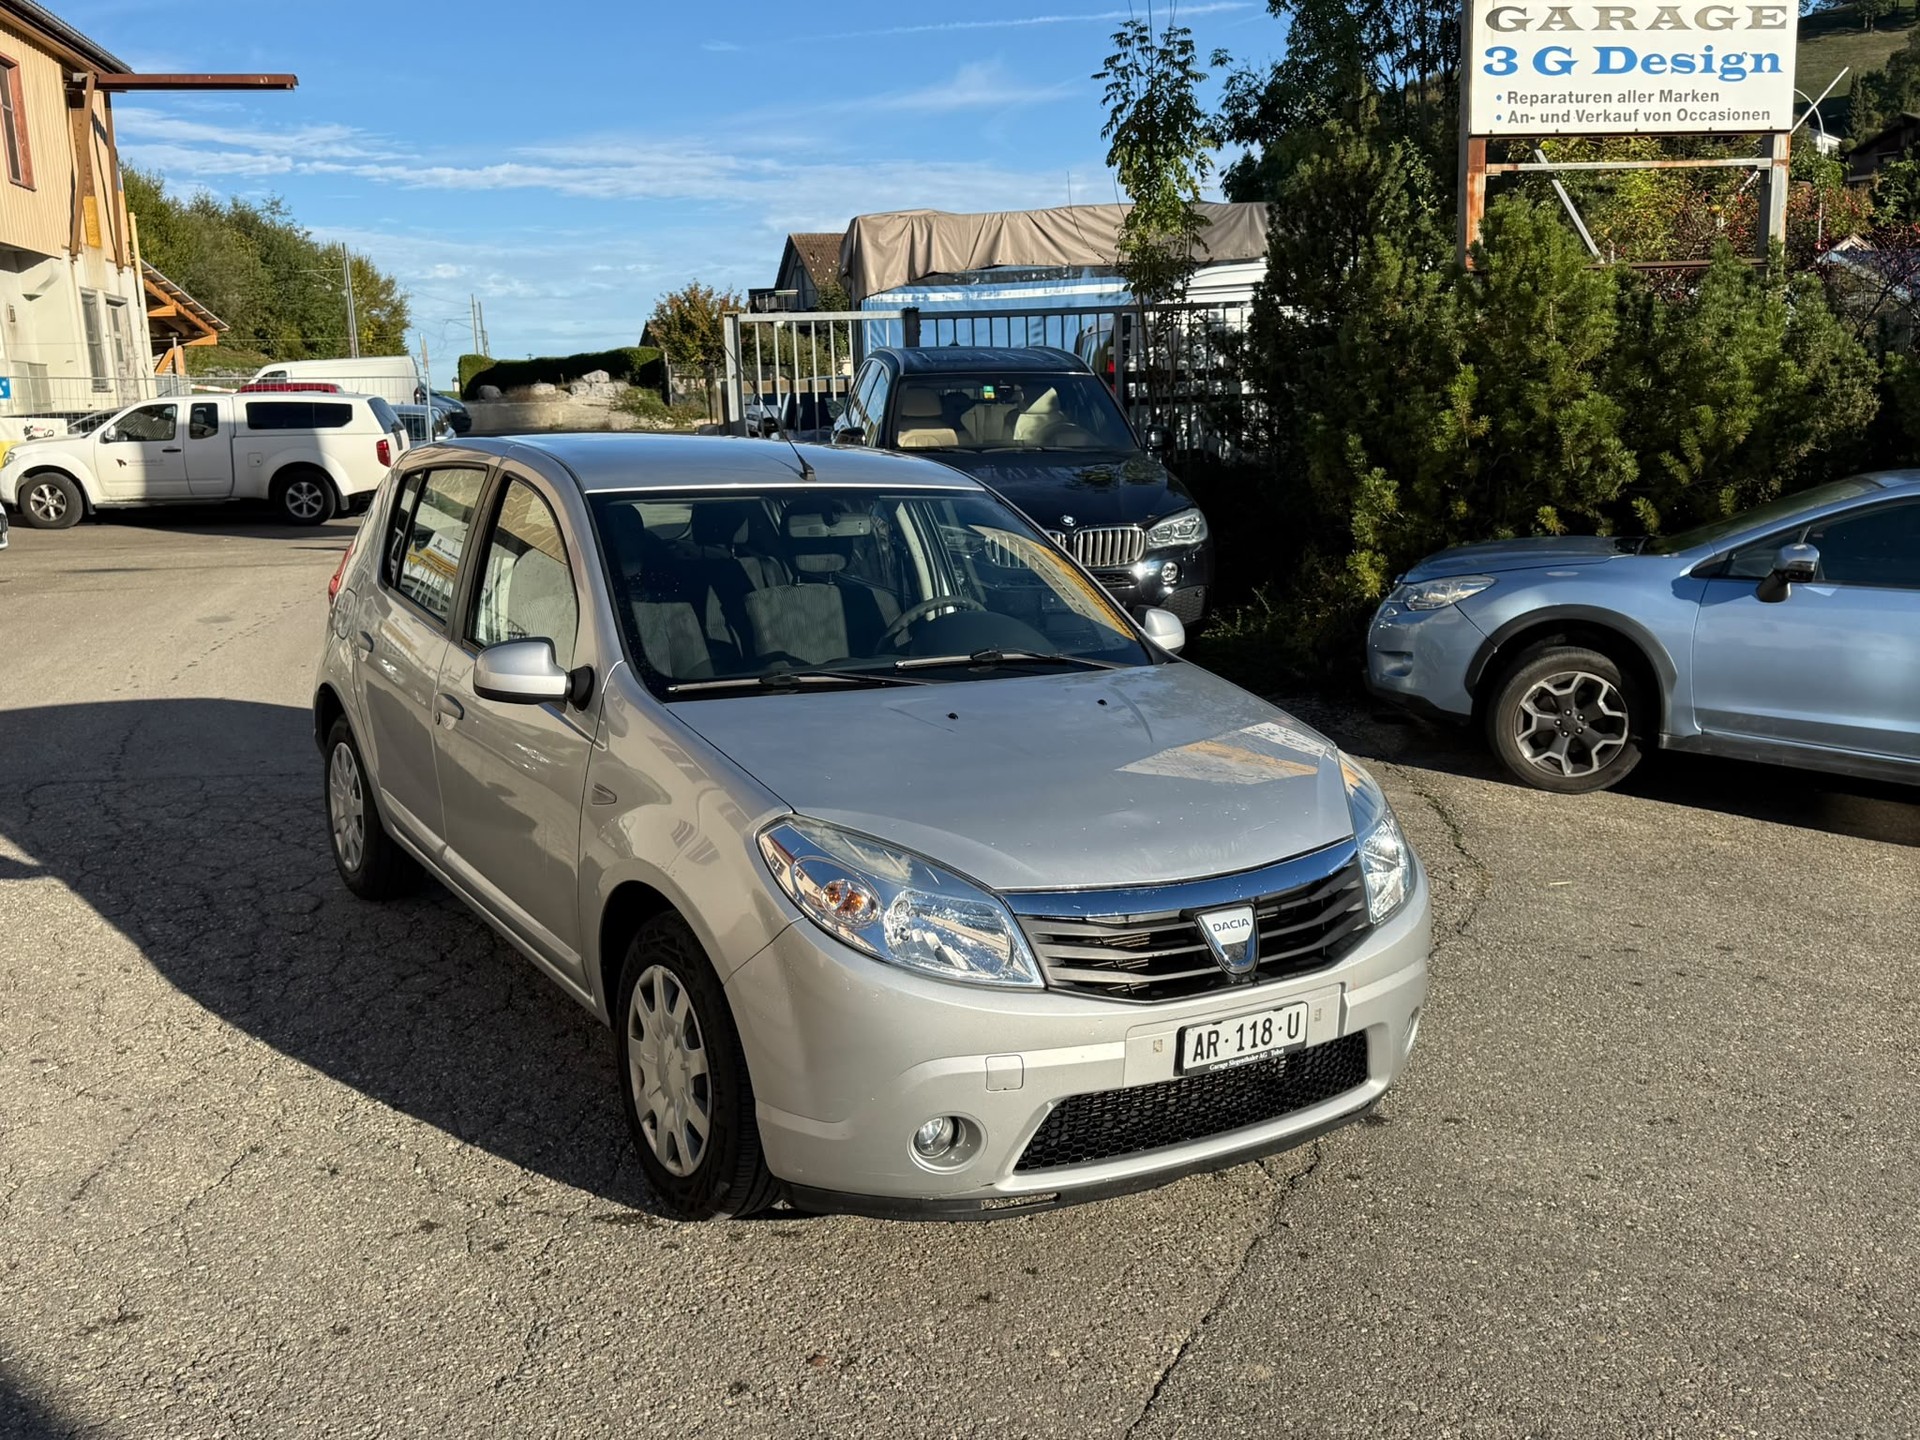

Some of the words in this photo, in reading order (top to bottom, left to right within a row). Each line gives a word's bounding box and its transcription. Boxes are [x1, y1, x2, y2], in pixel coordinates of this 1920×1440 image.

[1485, 5, 1788, 33] GARAGE
[1483, 46, 1519, 76] 3
[1532, 46, 1580, 76] G
[1591, 45, 1784, 82] Design
[1507, 90, 1613, 107] Reparaturen
[1617, 89, 1655, 104] aller
[1659, 89, 1720, 103] Marken
[1507, 110, 1535, 124] An-
[1540, 109, 1570, 123] und
[1575, 108, 1640, 123] Verkauf
[1643, 111, 1672, 122] von
[1676, 107, 1771, 122] Occasionen
[1212, 918, 1250, 932] DACIA
[1209, 1062, 1229, 1071] Garage
